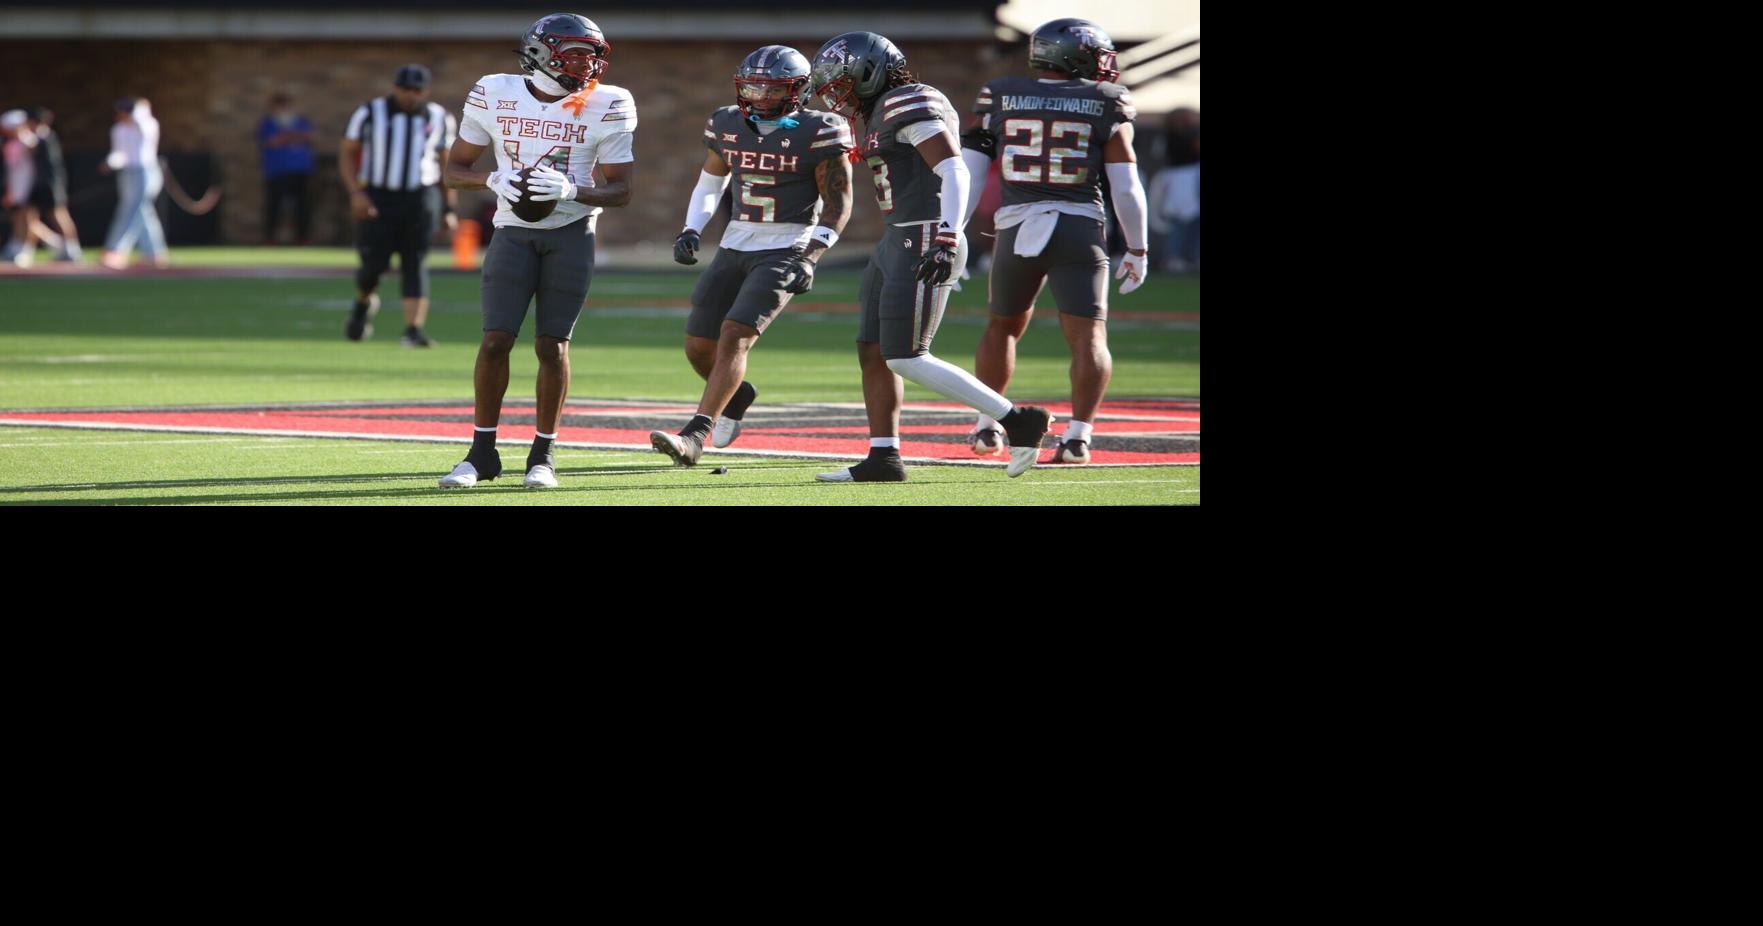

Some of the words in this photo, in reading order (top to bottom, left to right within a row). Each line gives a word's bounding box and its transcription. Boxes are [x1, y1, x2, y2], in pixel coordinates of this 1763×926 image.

[1001, 95, 1105, 117] RAMON-EDWARDS
[496, 116, 587, 143] TECH
[722, 148, 799, 172] TECH
[1001, 118, 1093, 185] 22
[739, 172, 777, 223] 5
